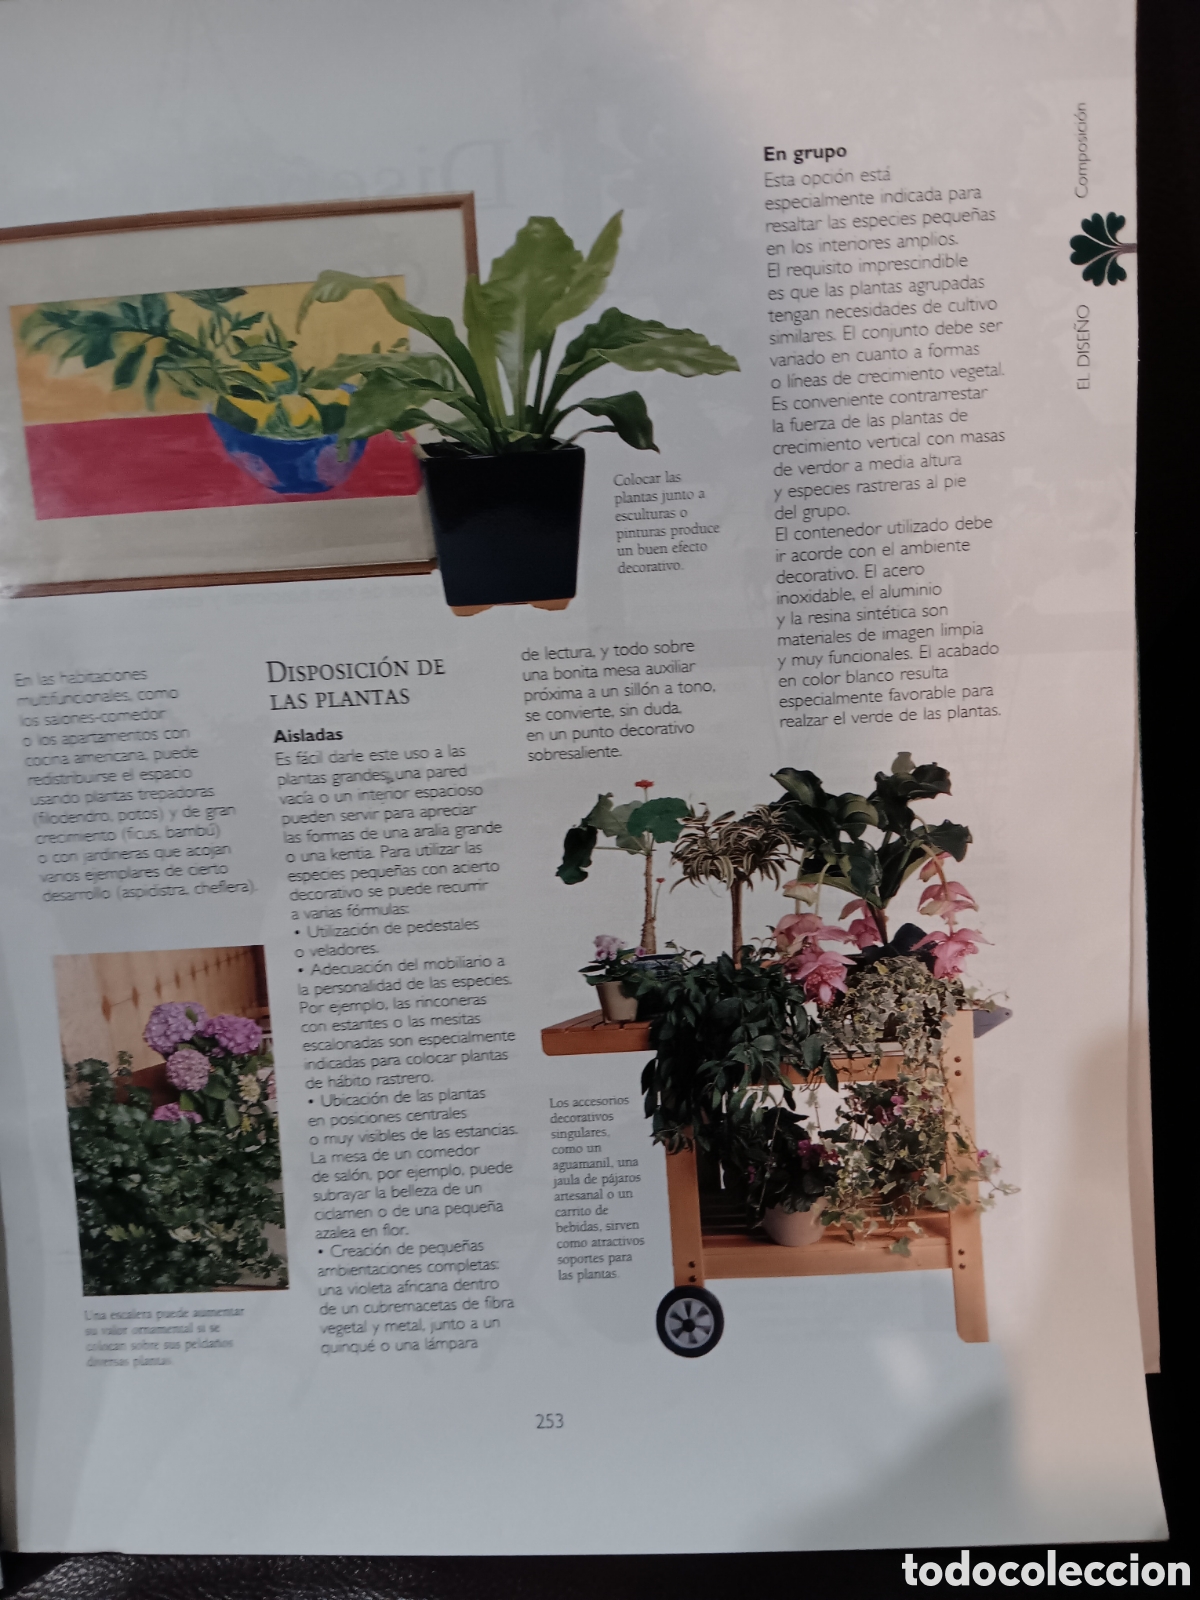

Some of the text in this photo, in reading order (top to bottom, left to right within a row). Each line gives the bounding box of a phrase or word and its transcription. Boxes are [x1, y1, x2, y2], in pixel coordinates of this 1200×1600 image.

[764, 147, 847, 164] En grupo
[1074, 102, 1091, 199] Composición
[764, 167, 891, 188] Esta opción está
[764, 187, 982, 212] especialmente indicada para
[766, 207, 996, 233] resaltar las especies pequeñas
[766, 232, 959, 255] en los interiores amplios.
[767, 253, 968, 279] El requisito imprescindible
[767, 275, 985, 302] es que las plantas agrupadas
[768, 298, 998, 325] tengan necesidades de cultivo
[1073, 304, 1090, 390] EL DISEÑO
[773, 431, 1006, 454] crecimiento vertical con masas
[773, 453, 962, 476] de verdor a media altura
[613, 471, 682, 486] Colocar las
[614, 490, 706, 507] plantas junto a
[615, 507, 688, 522] esculturas o
[774, 504, 850, 523] del grupo.
[616, 522, 720, 542] pinturas produce
[775, 515, 993, 541] El contenedor utilizado debe
[616, 540, 708, 556] un buen efecto
[617, 560, 685, 574] decorativo.
[776, 563, 925, 584] decorativo. El acero
[777, 583, 942, 605] inoxidable, el aluminio
[778, 622, 984, 646] materiales de imagen limpia
[266, 657, 446, 682] DISPOSICIÓN DE
[523, 659, 696, 682] una bonita mesa auxiliar
[778, 665, 949, 687] en color blanco resulta
[269, 688, 410, 711] LAS PLANTAS
[779, 685, 994, 711] especialmente favorable para
[780, 704, 1001, 728] realzar el verde de las plantas.
[274, 728, 344, 743] Aisladas
[526, 722, 695, 743] en un punto decorativo
[528, 745, 622, 761] sobresaliente.
[308, 918, 480, 938] Utilización de pedestales
[299, 995, 487, 1016] Por ejemplo, las rinconeras
[302, 1030, 516, 1052] escalonadas son especialmente
[305, 1073, 434, 1089] de hábito rastrero.
[549, 1095, 630, 1109] Los accesorios
[307, 1106, 467, 1128] en posiciones centrales
[550, 1111, 614, 1124] decorativos
[311, 1143, 480, 1164] La mesa de un comedor
[551, 1144, 602, 1155] como un
[311, 1160, 514, 1183] de salón, por ejemplo, puede
[553, 1172, 642, 1189] jaula de pájaros
[554, 1187, 634, 1202] artesanal o un
[315, 1222, 409, 1240] azalea en flor.
[555, 1220, 640, 1233] bebidas, sirven
[330, 1239, 484, 1258] Creación de pequeñas
[556, 1236, 646, 1249] como atractivos
[557, 1253, 633, 1268] soportes para
[319, 1278, 500, 1296] una violeta africana dentro
[535, 1413, 564, 1429] 253
